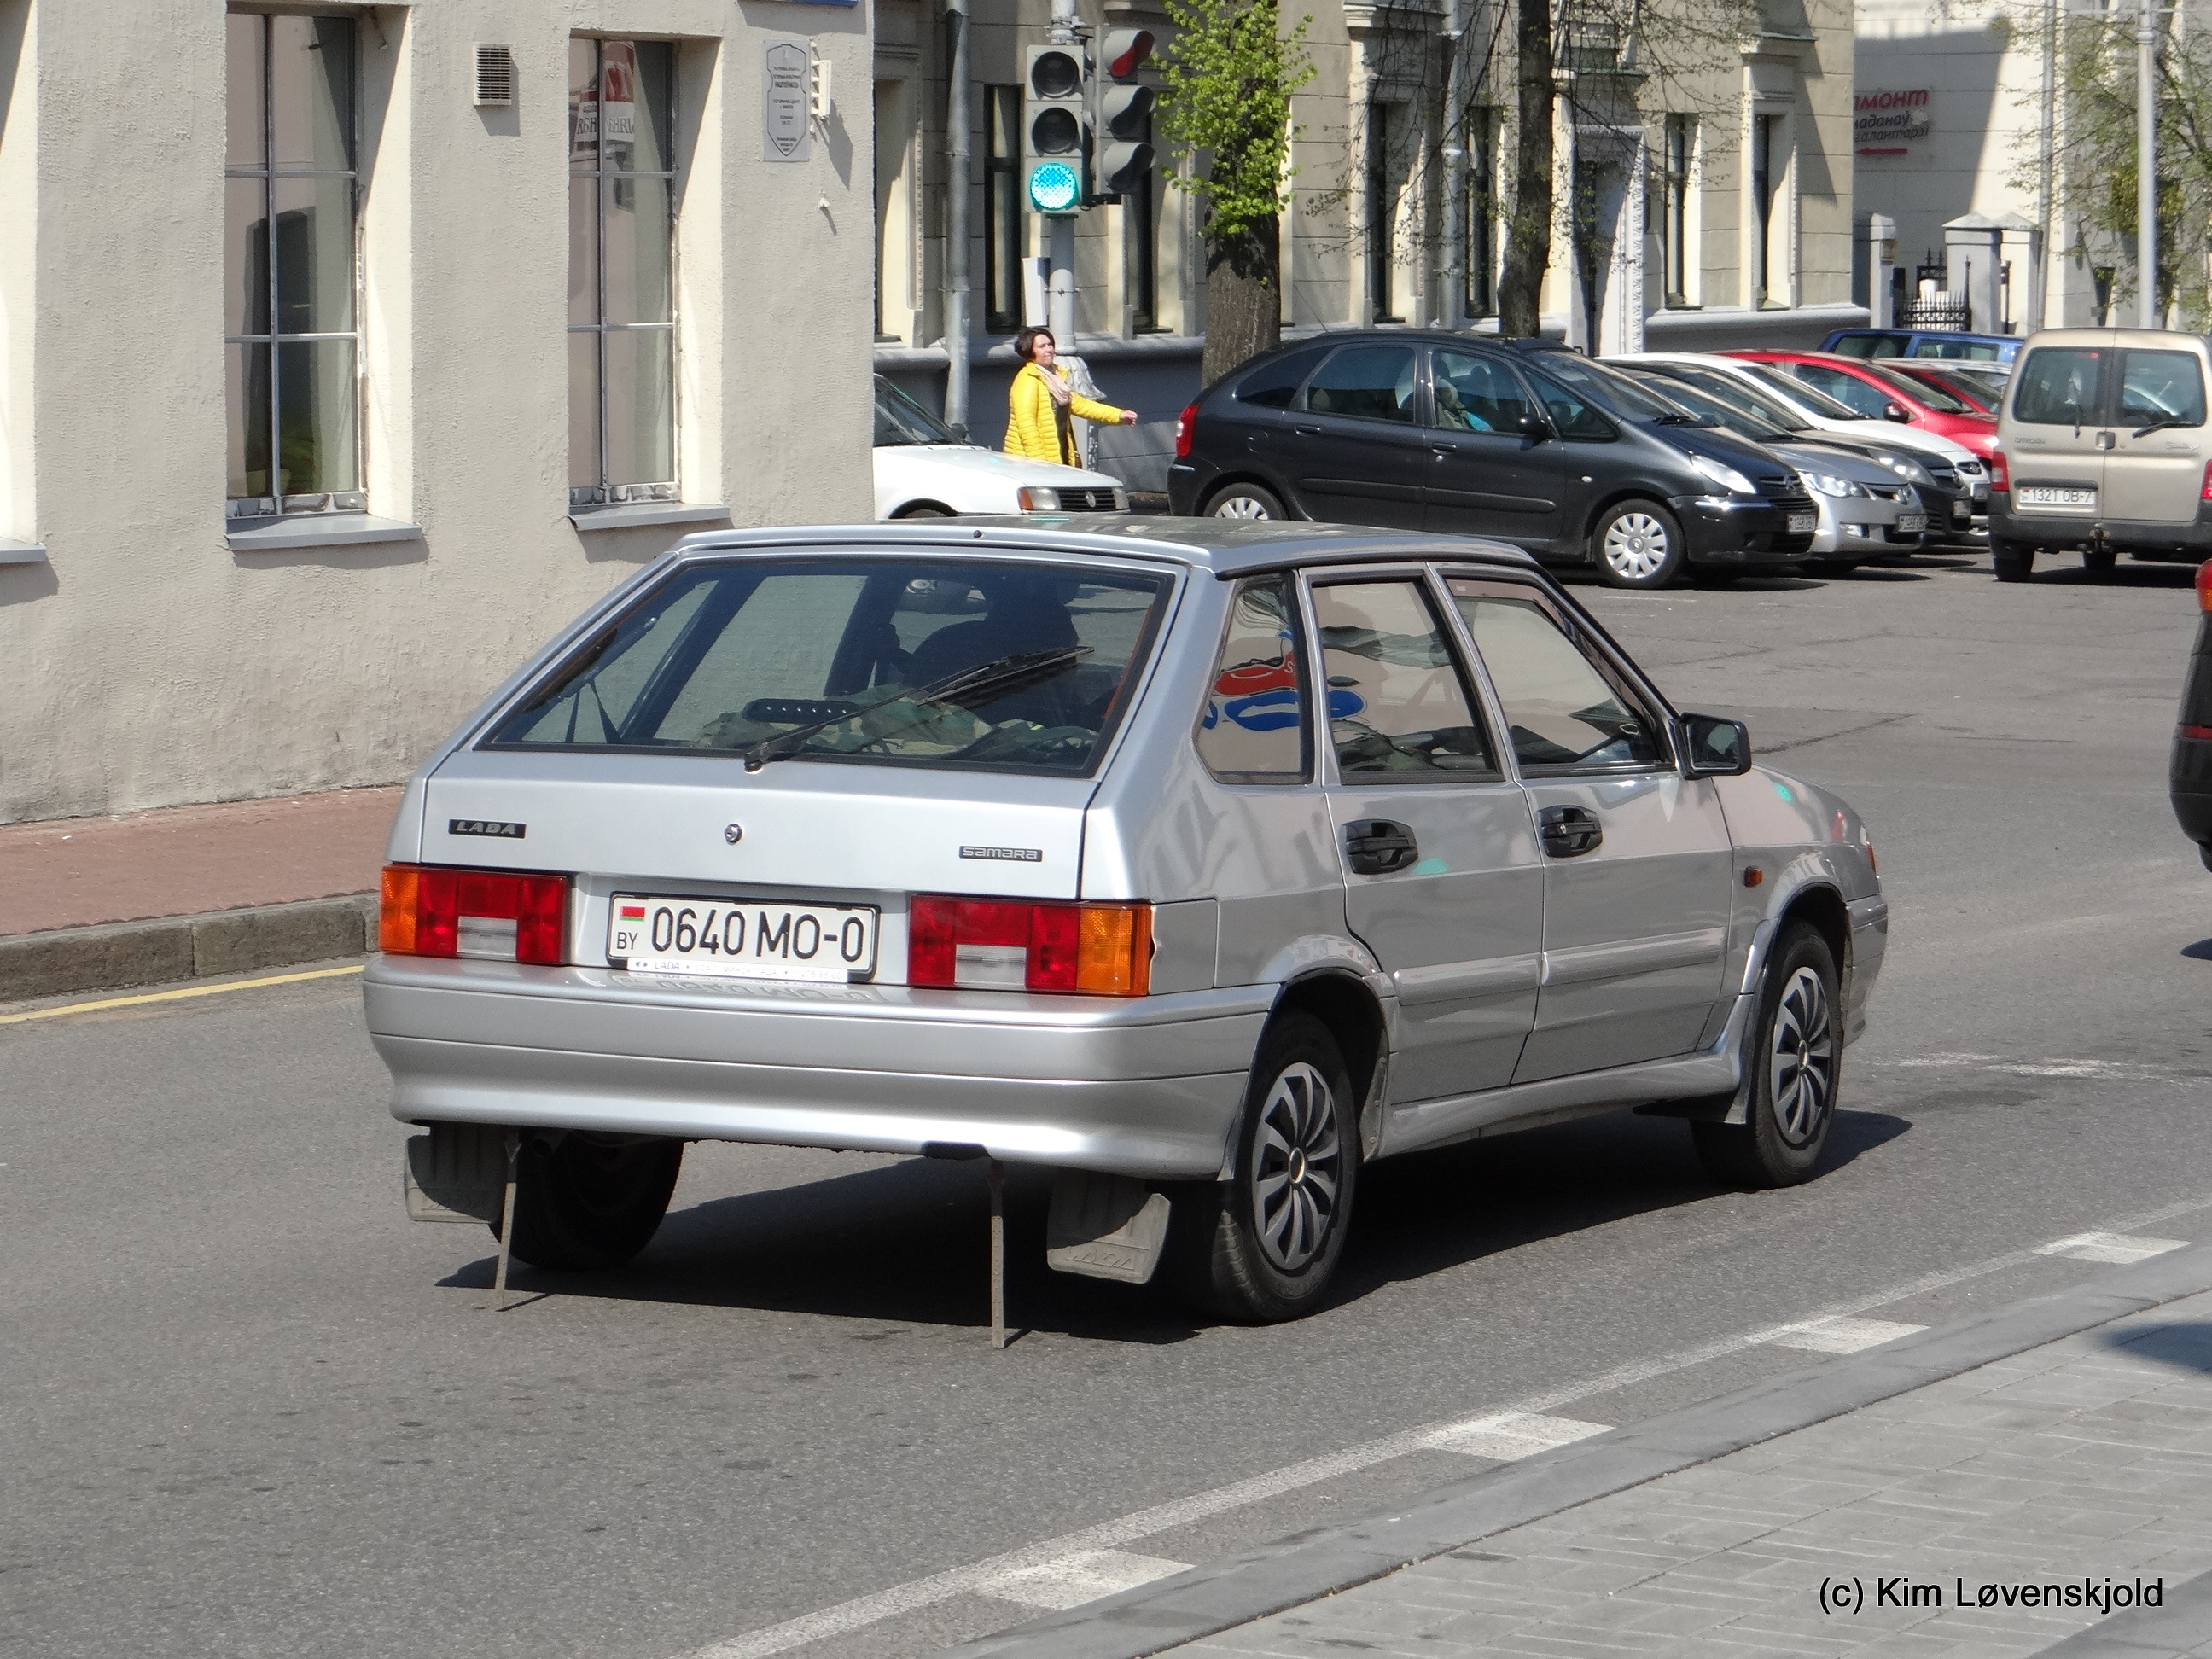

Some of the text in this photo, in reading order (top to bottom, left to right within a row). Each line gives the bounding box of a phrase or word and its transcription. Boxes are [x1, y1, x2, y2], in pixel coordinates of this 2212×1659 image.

[2033, 487, 2058, 502] 1321
[456, 821, 515, 835] LADA
[616, 906, 864, 962] BY 0640 MO-0
[655, 961, 681, 971] LADA
